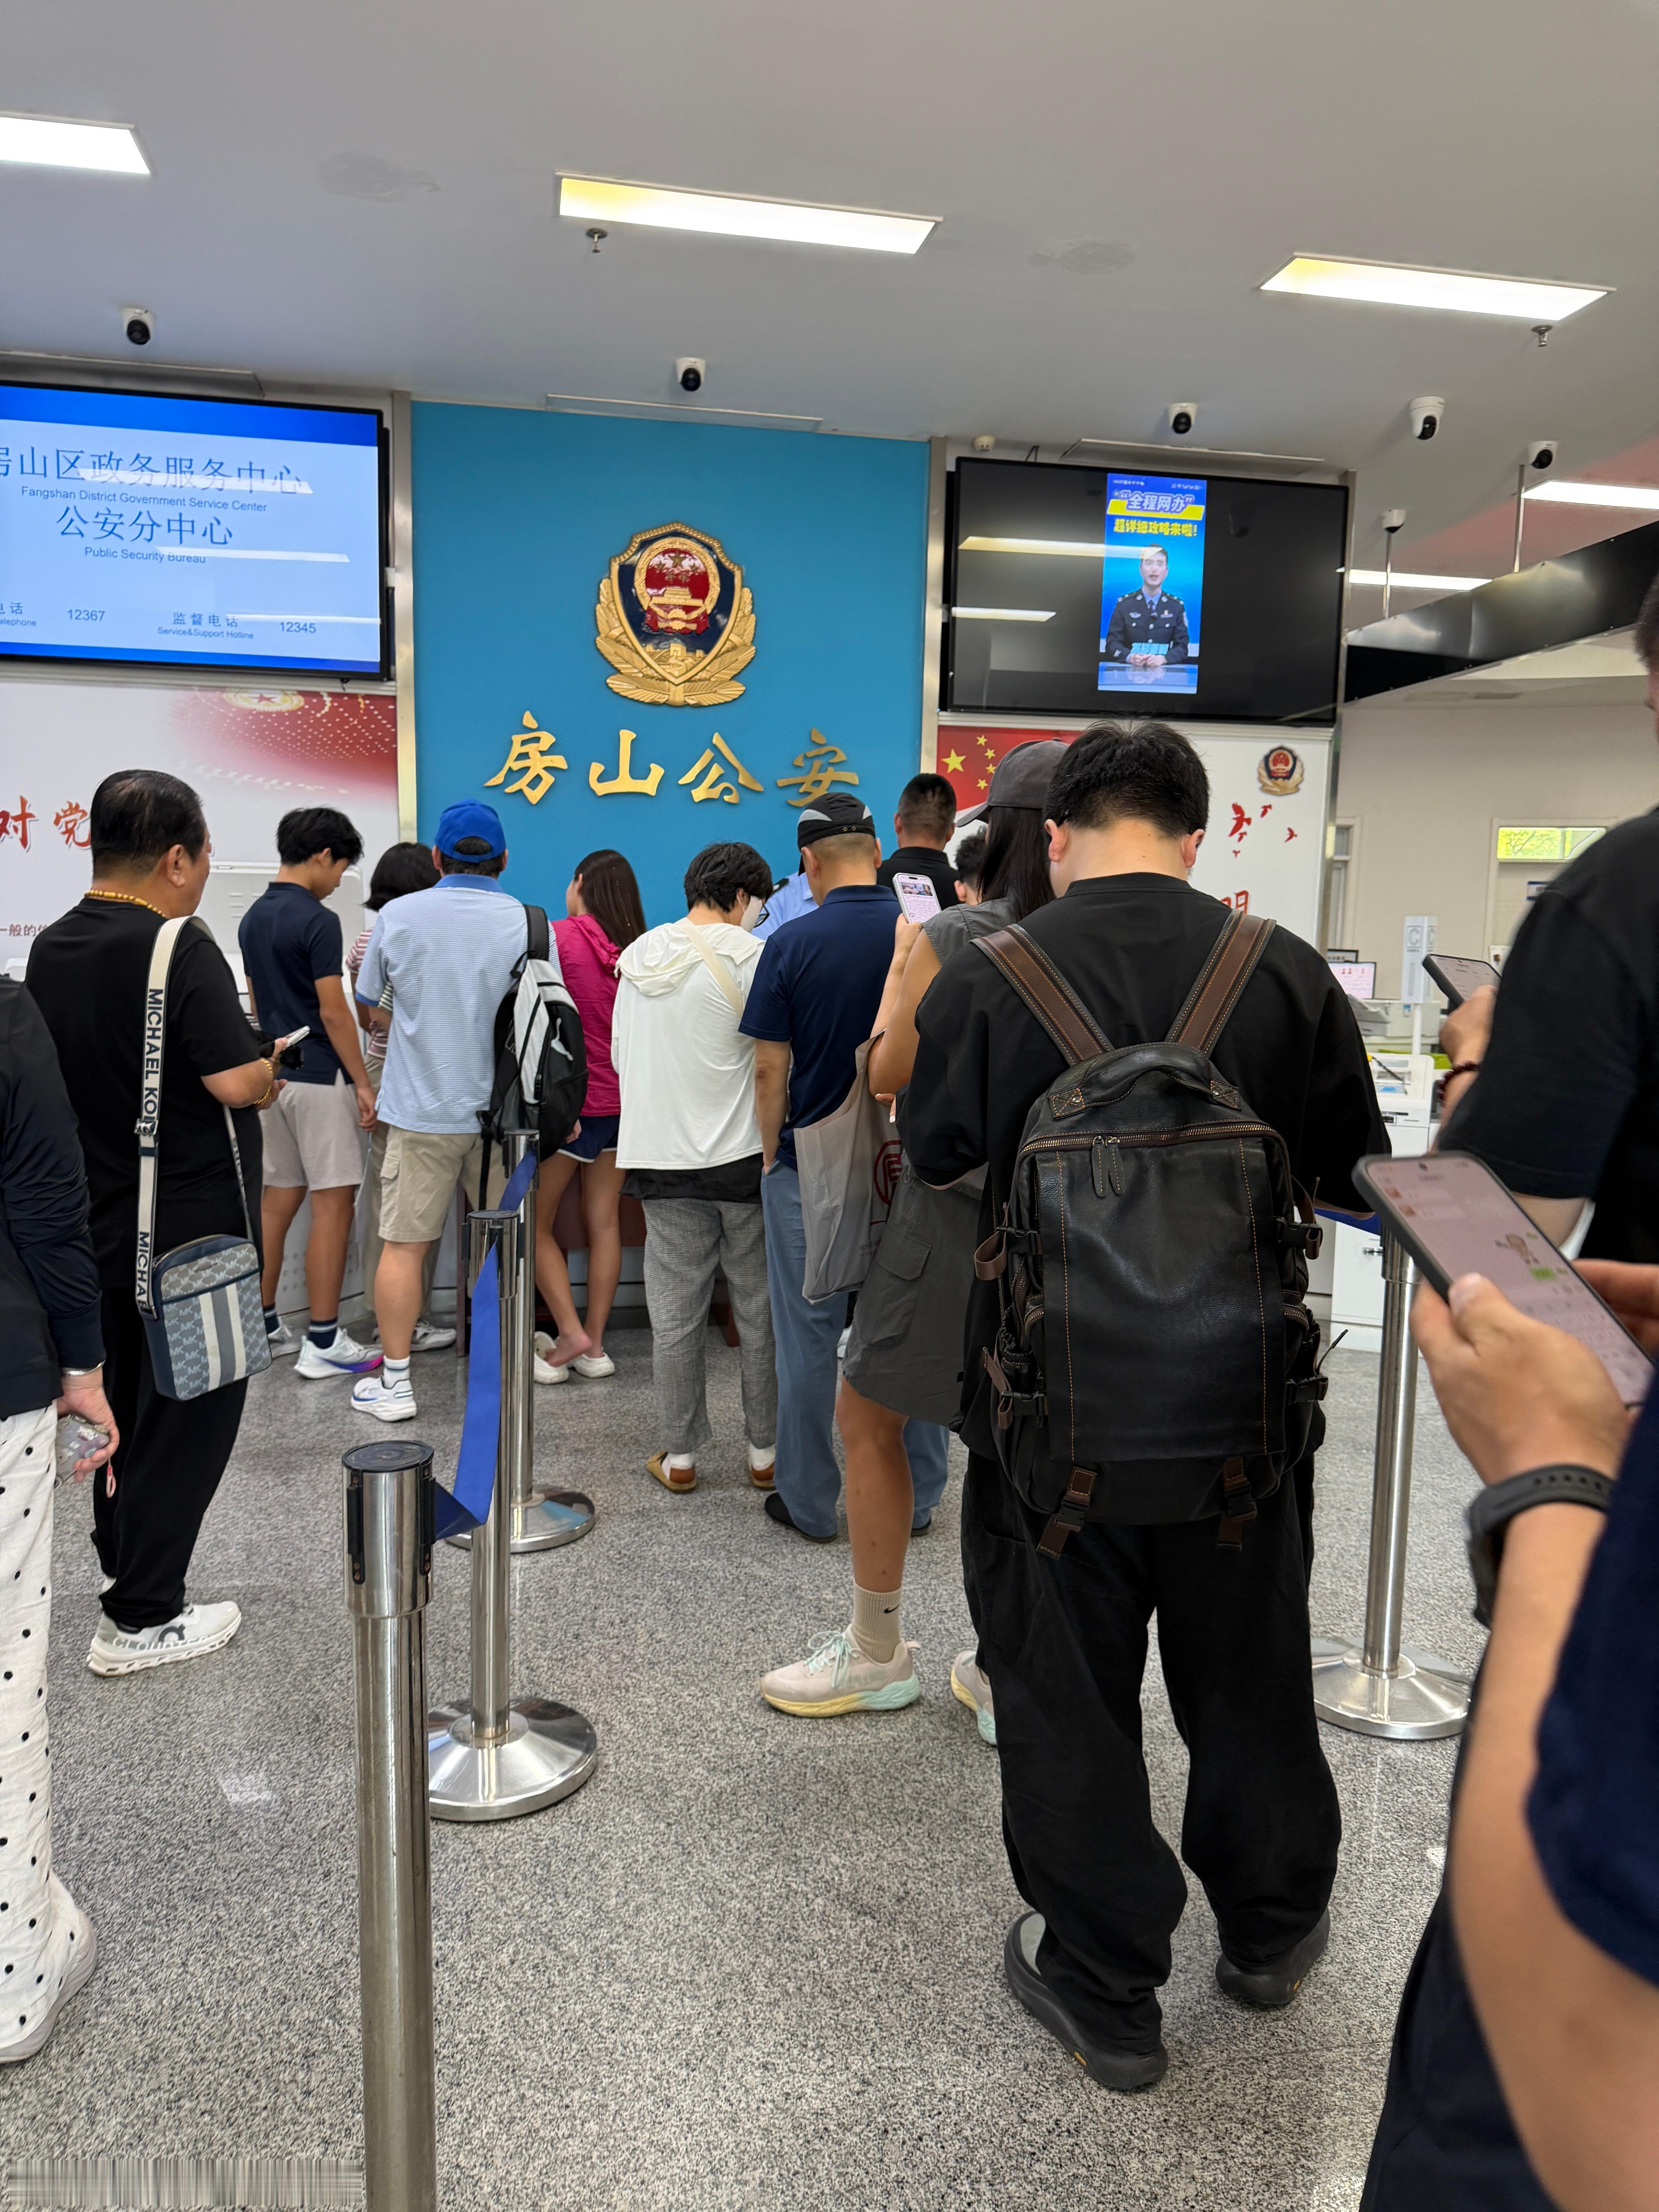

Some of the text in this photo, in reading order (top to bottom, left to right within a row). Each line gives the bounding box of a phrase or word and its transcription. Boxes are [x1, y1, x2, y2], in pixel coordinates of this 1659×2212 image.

[22, 486, 267, 512] Fangshan District Government Service Center
[57, 505, 232, 544] 公安分中心
[85, 547, 206, 563] Public Security Bureau
[68, 609, 105, 622] 12367
[173, 612, 238, 627] 监督电话
[158, 627, 253, 639] Service&Support Hotline
[280, 622, 316, 633] 12345
[484, 710, 859, 807] 房山公安
[145, 989, 164, 1080] MICHAEL
[137, 1231, 150, 1307] MICHAE
